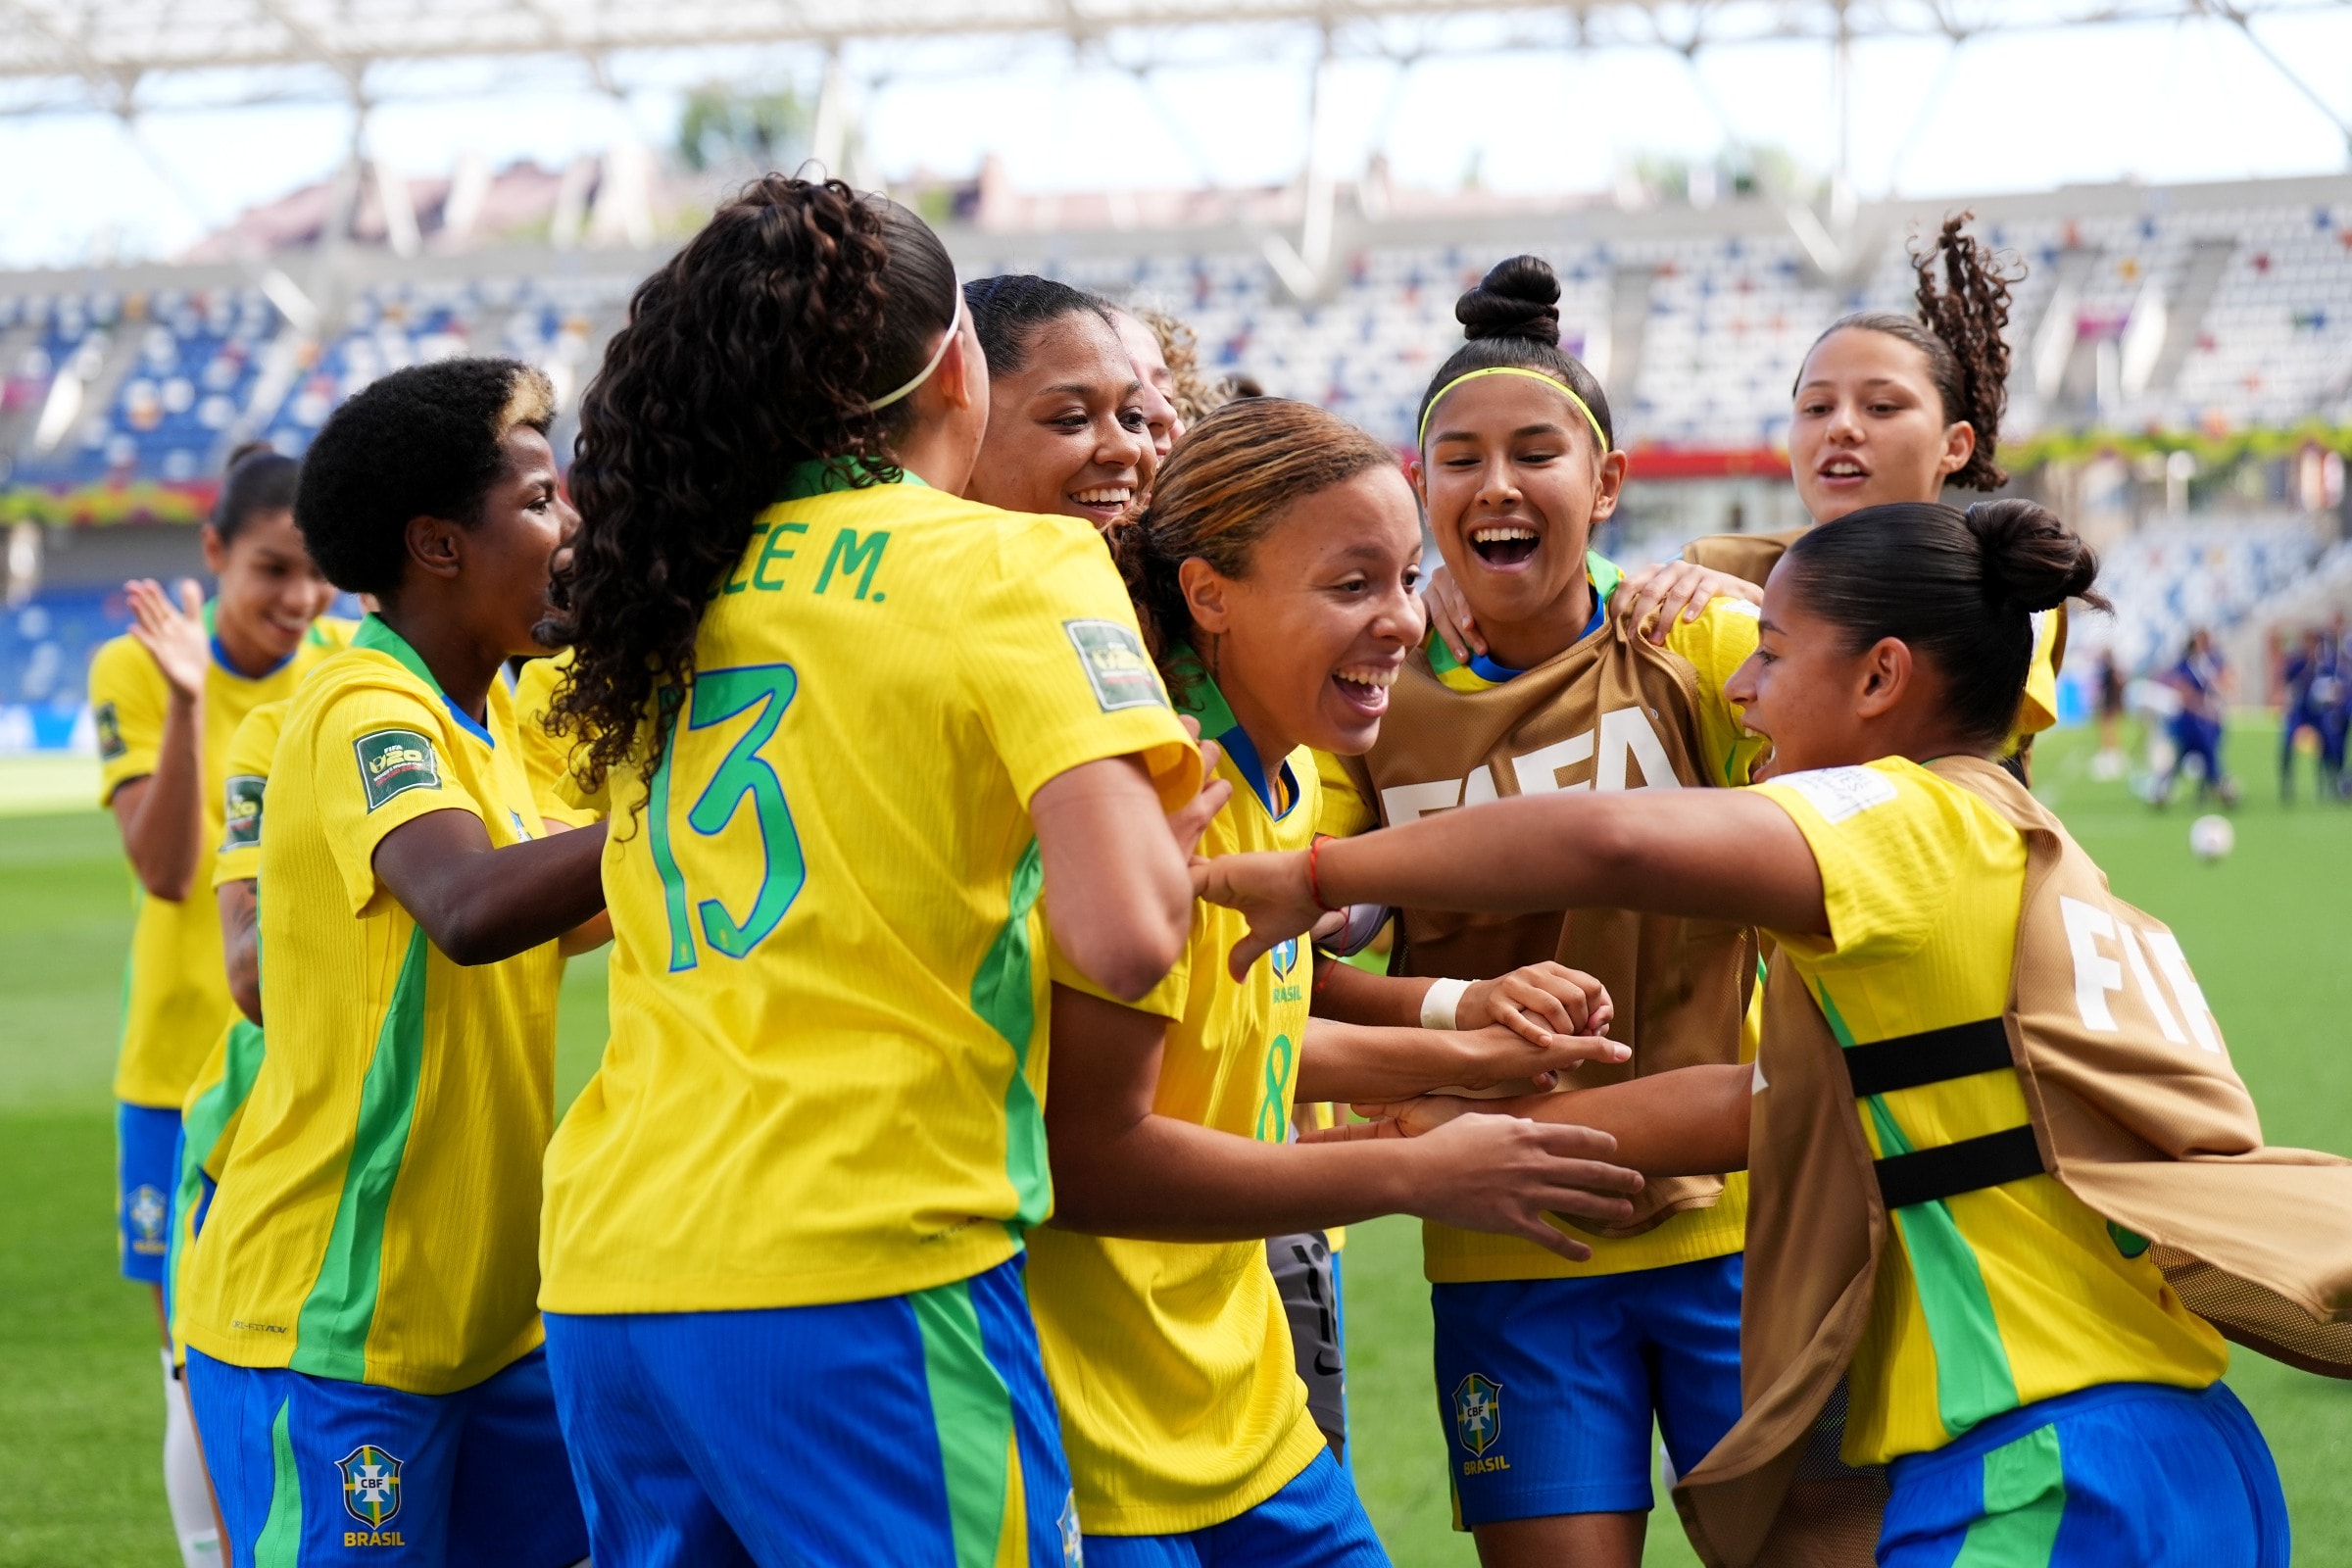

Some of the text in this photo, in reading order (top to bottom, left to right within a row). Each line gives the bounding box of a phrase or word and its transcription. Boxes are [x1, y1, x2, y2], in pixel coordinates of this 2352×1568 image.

[812, 527, 891, 603] M.
[383, 744, 404, 755] FIFA
[647, 662, 806, 973] 13
[1255, 1033, 1293, 1145] 8
[1467, 1405, 1484, 1417] CBF
[1463, 1455, 1510, 1476] BRASIL
[361, 1478, 383, 1489] CBF
[344, 1531, 406, 1547] BRASIL
